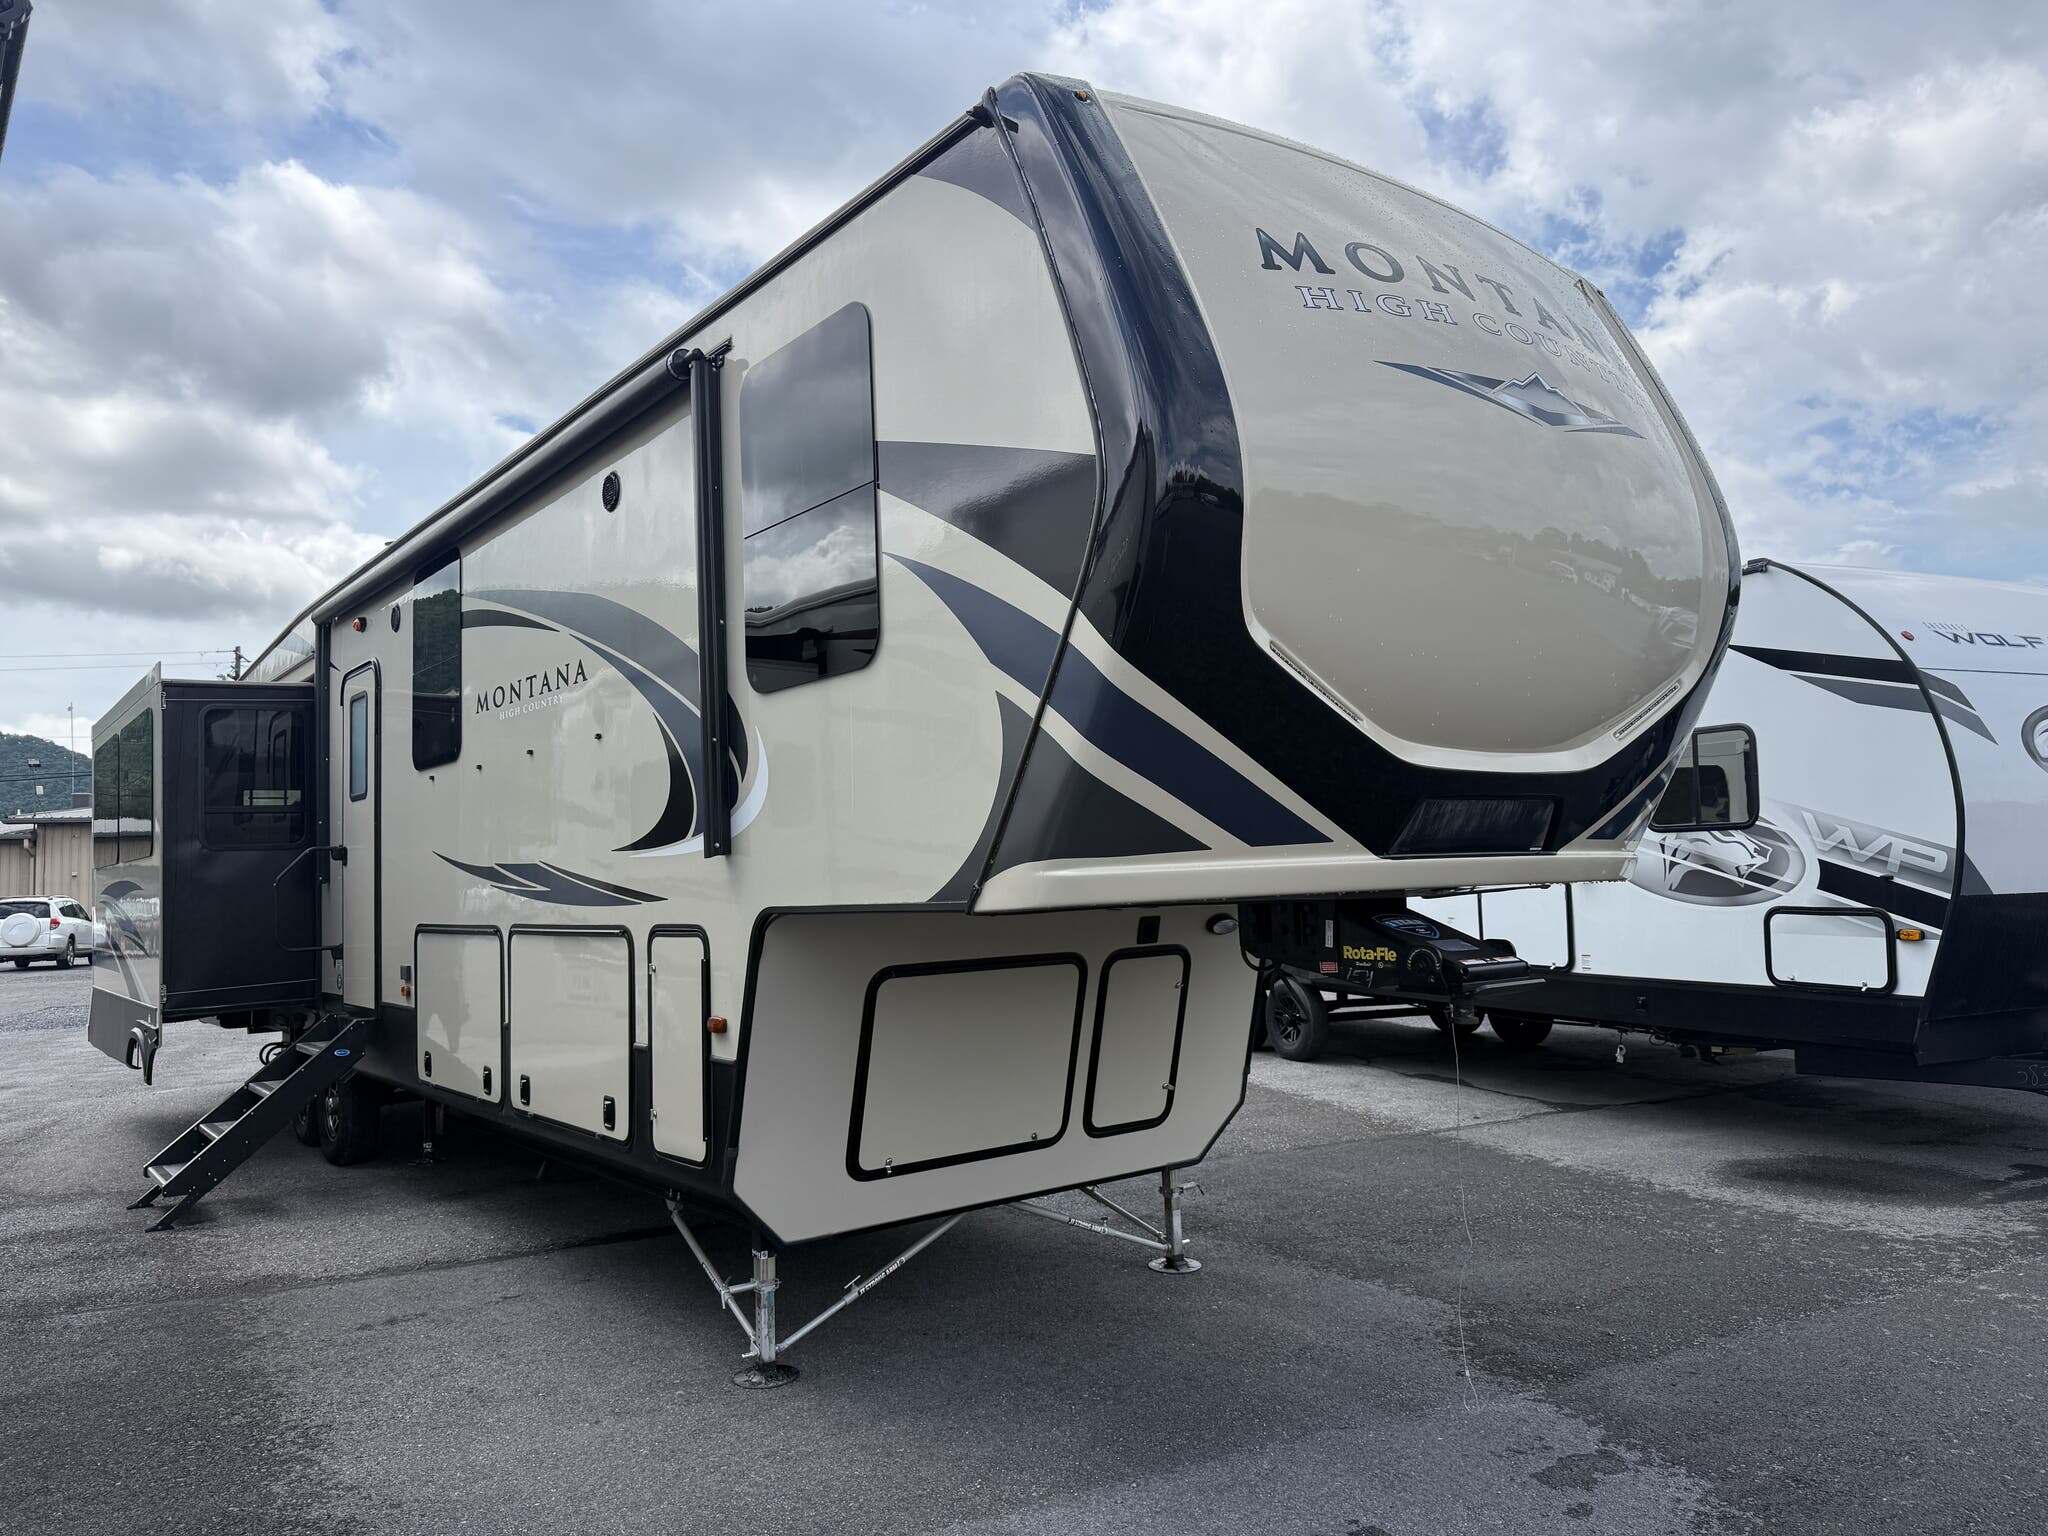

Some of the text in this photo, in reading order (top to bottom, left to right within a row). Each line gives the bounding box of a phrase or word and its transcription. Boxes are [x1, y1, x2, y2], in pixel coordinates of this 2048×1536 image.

[1294, 284, 1459, 326] HIGH
[1932, 629, 2044, 649] WOLF
[475, 658, 588, 714] MONTANA
[499, 694, 565, 721] HIGH COUNTRY
